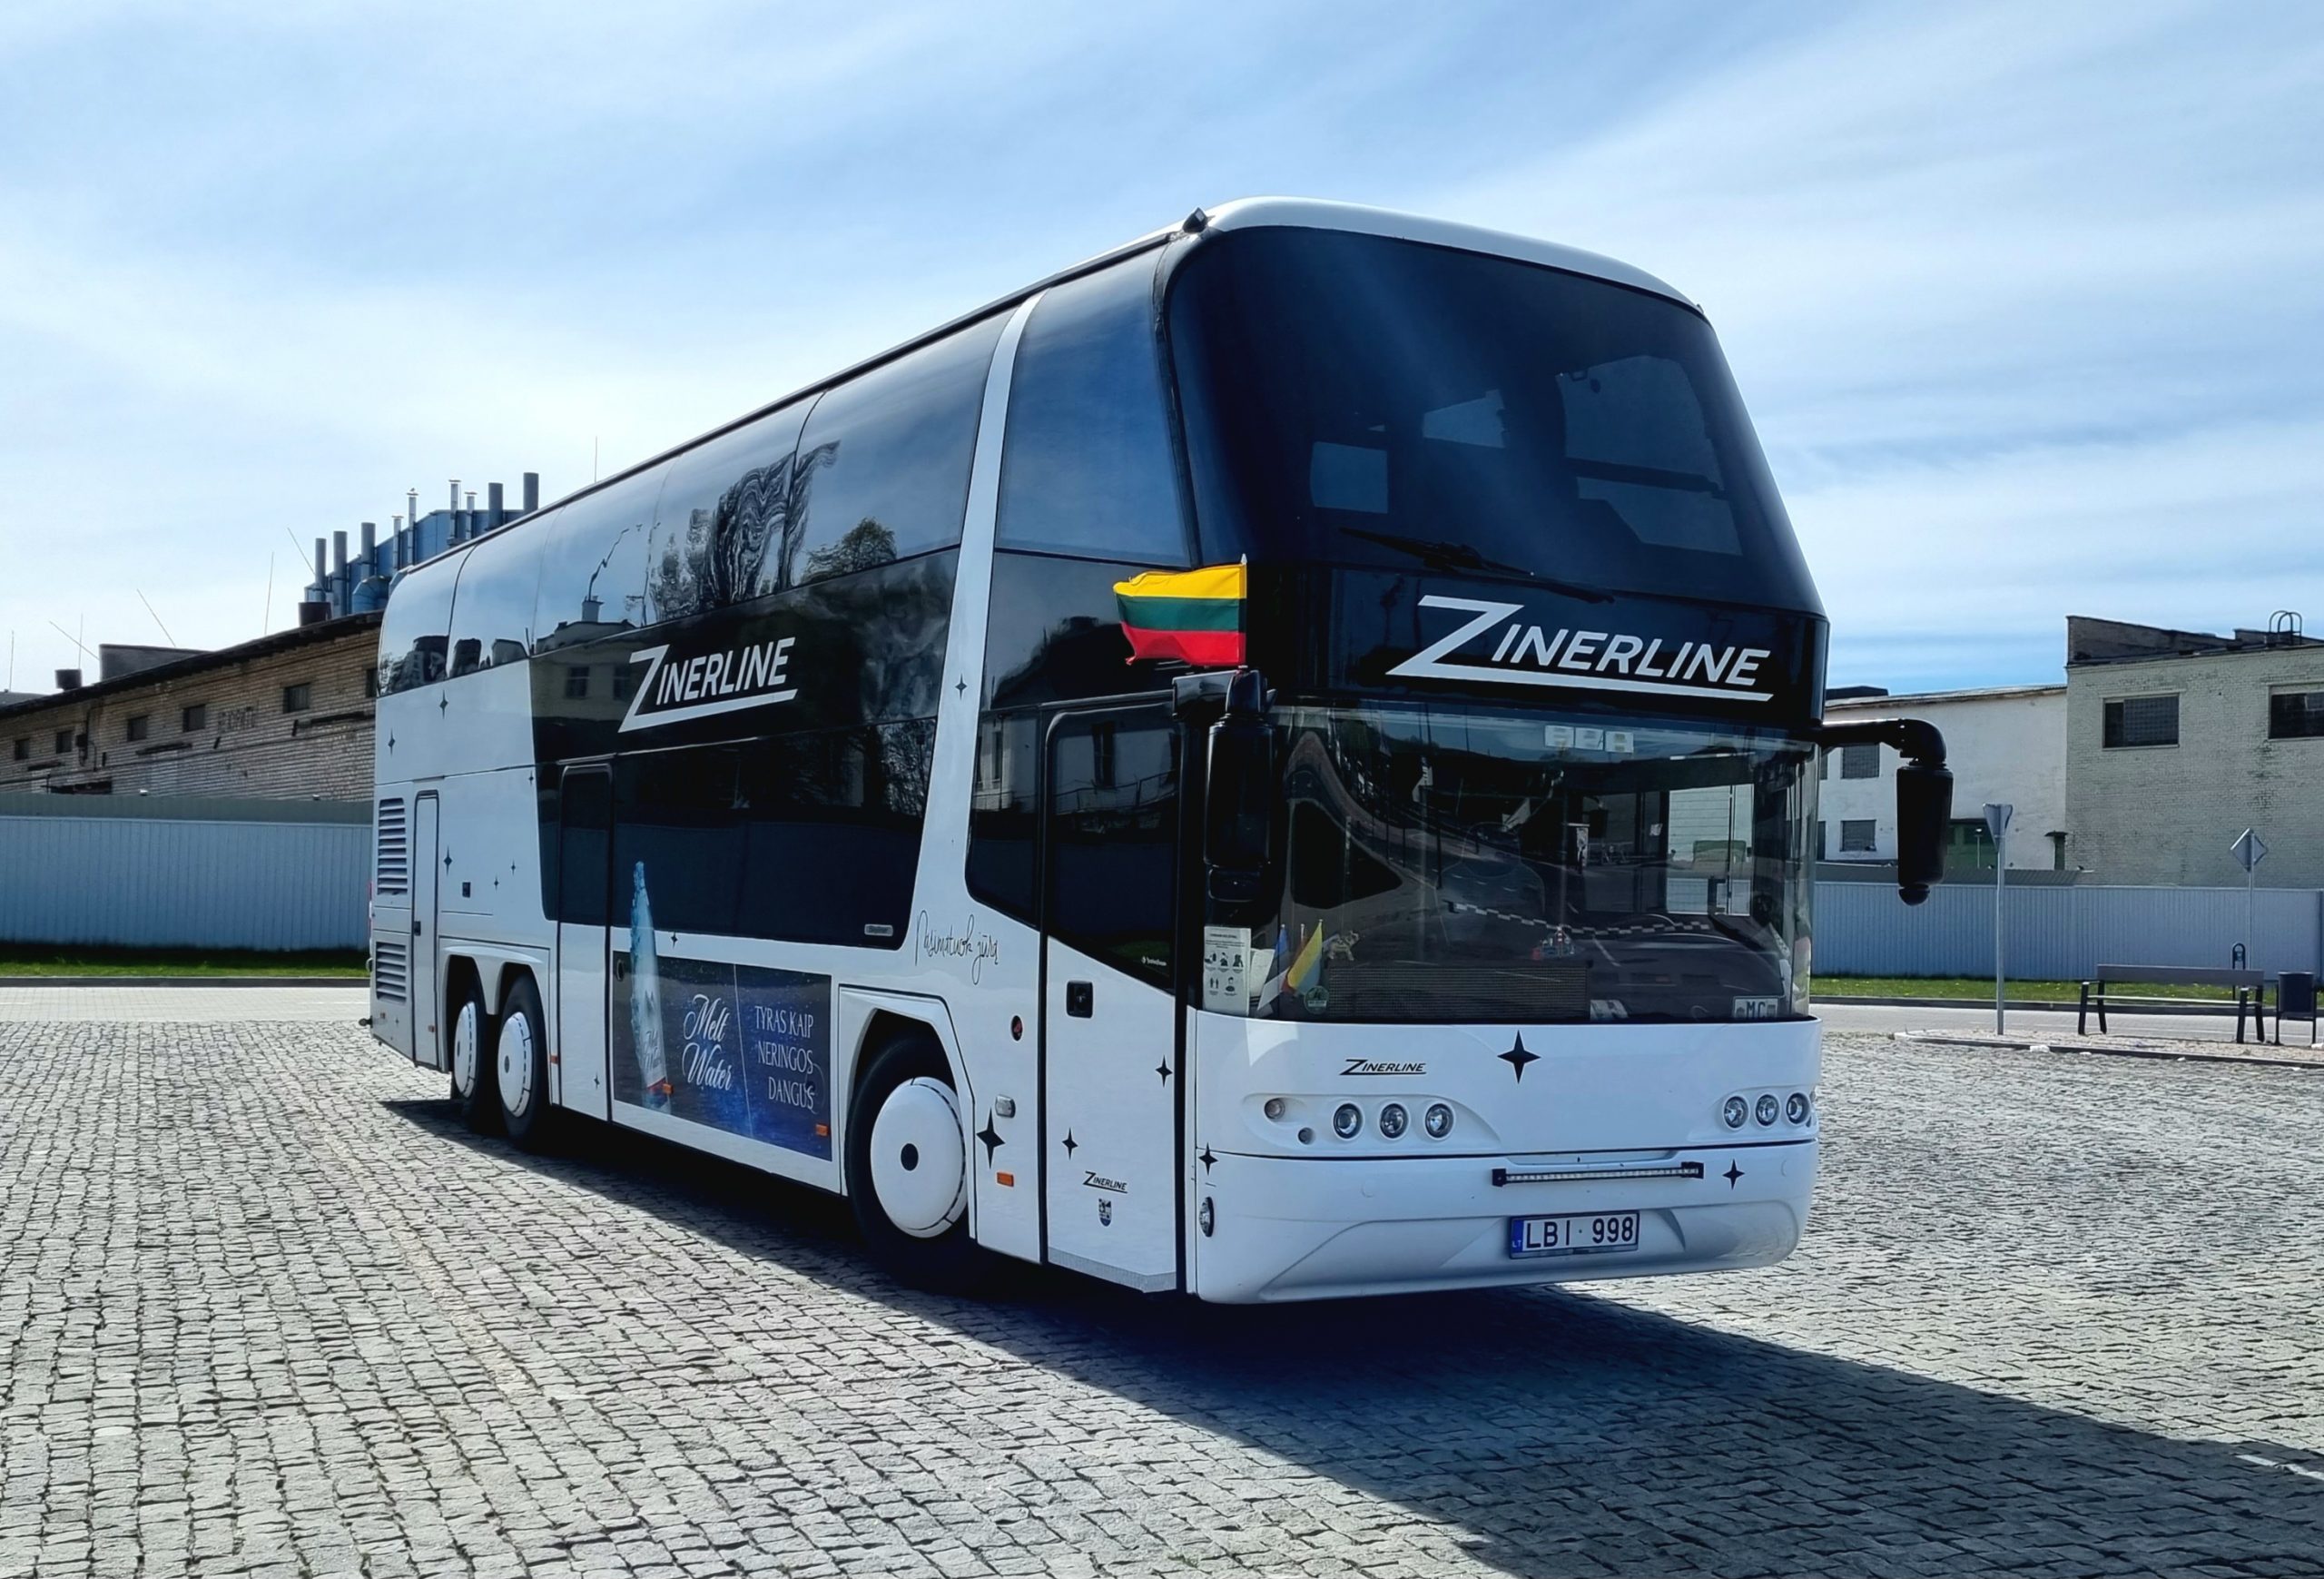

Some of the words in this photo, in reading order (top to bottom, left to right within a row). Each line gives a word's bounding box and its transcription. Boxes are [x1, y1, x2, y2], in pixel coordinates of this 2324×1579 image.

[1385, 595, 1774, 702] ZINERLINE
[617, 637, 798, 733] ZINERLINE
[684, 993, 730, 1042] Melt
[755, 1005, 787, 1034] TYRAS
[788, 1012, 813, 1039] KAIP
[682, 1042, 732, 1090] Water
[758, 1041, 813, 1074] NERINGOS
[1339, 1059, 1426, 1075] ZINERLINE
[769, 1077, 814, 1110] DANGUS
[1082, 1170, 1128, 1194] ZINERLINE
[1512, 1239, 1522, 1248] LT
[1526, 1219, 1571, 1248] LBI
[1592, 1217, 1634, 1244] 998
